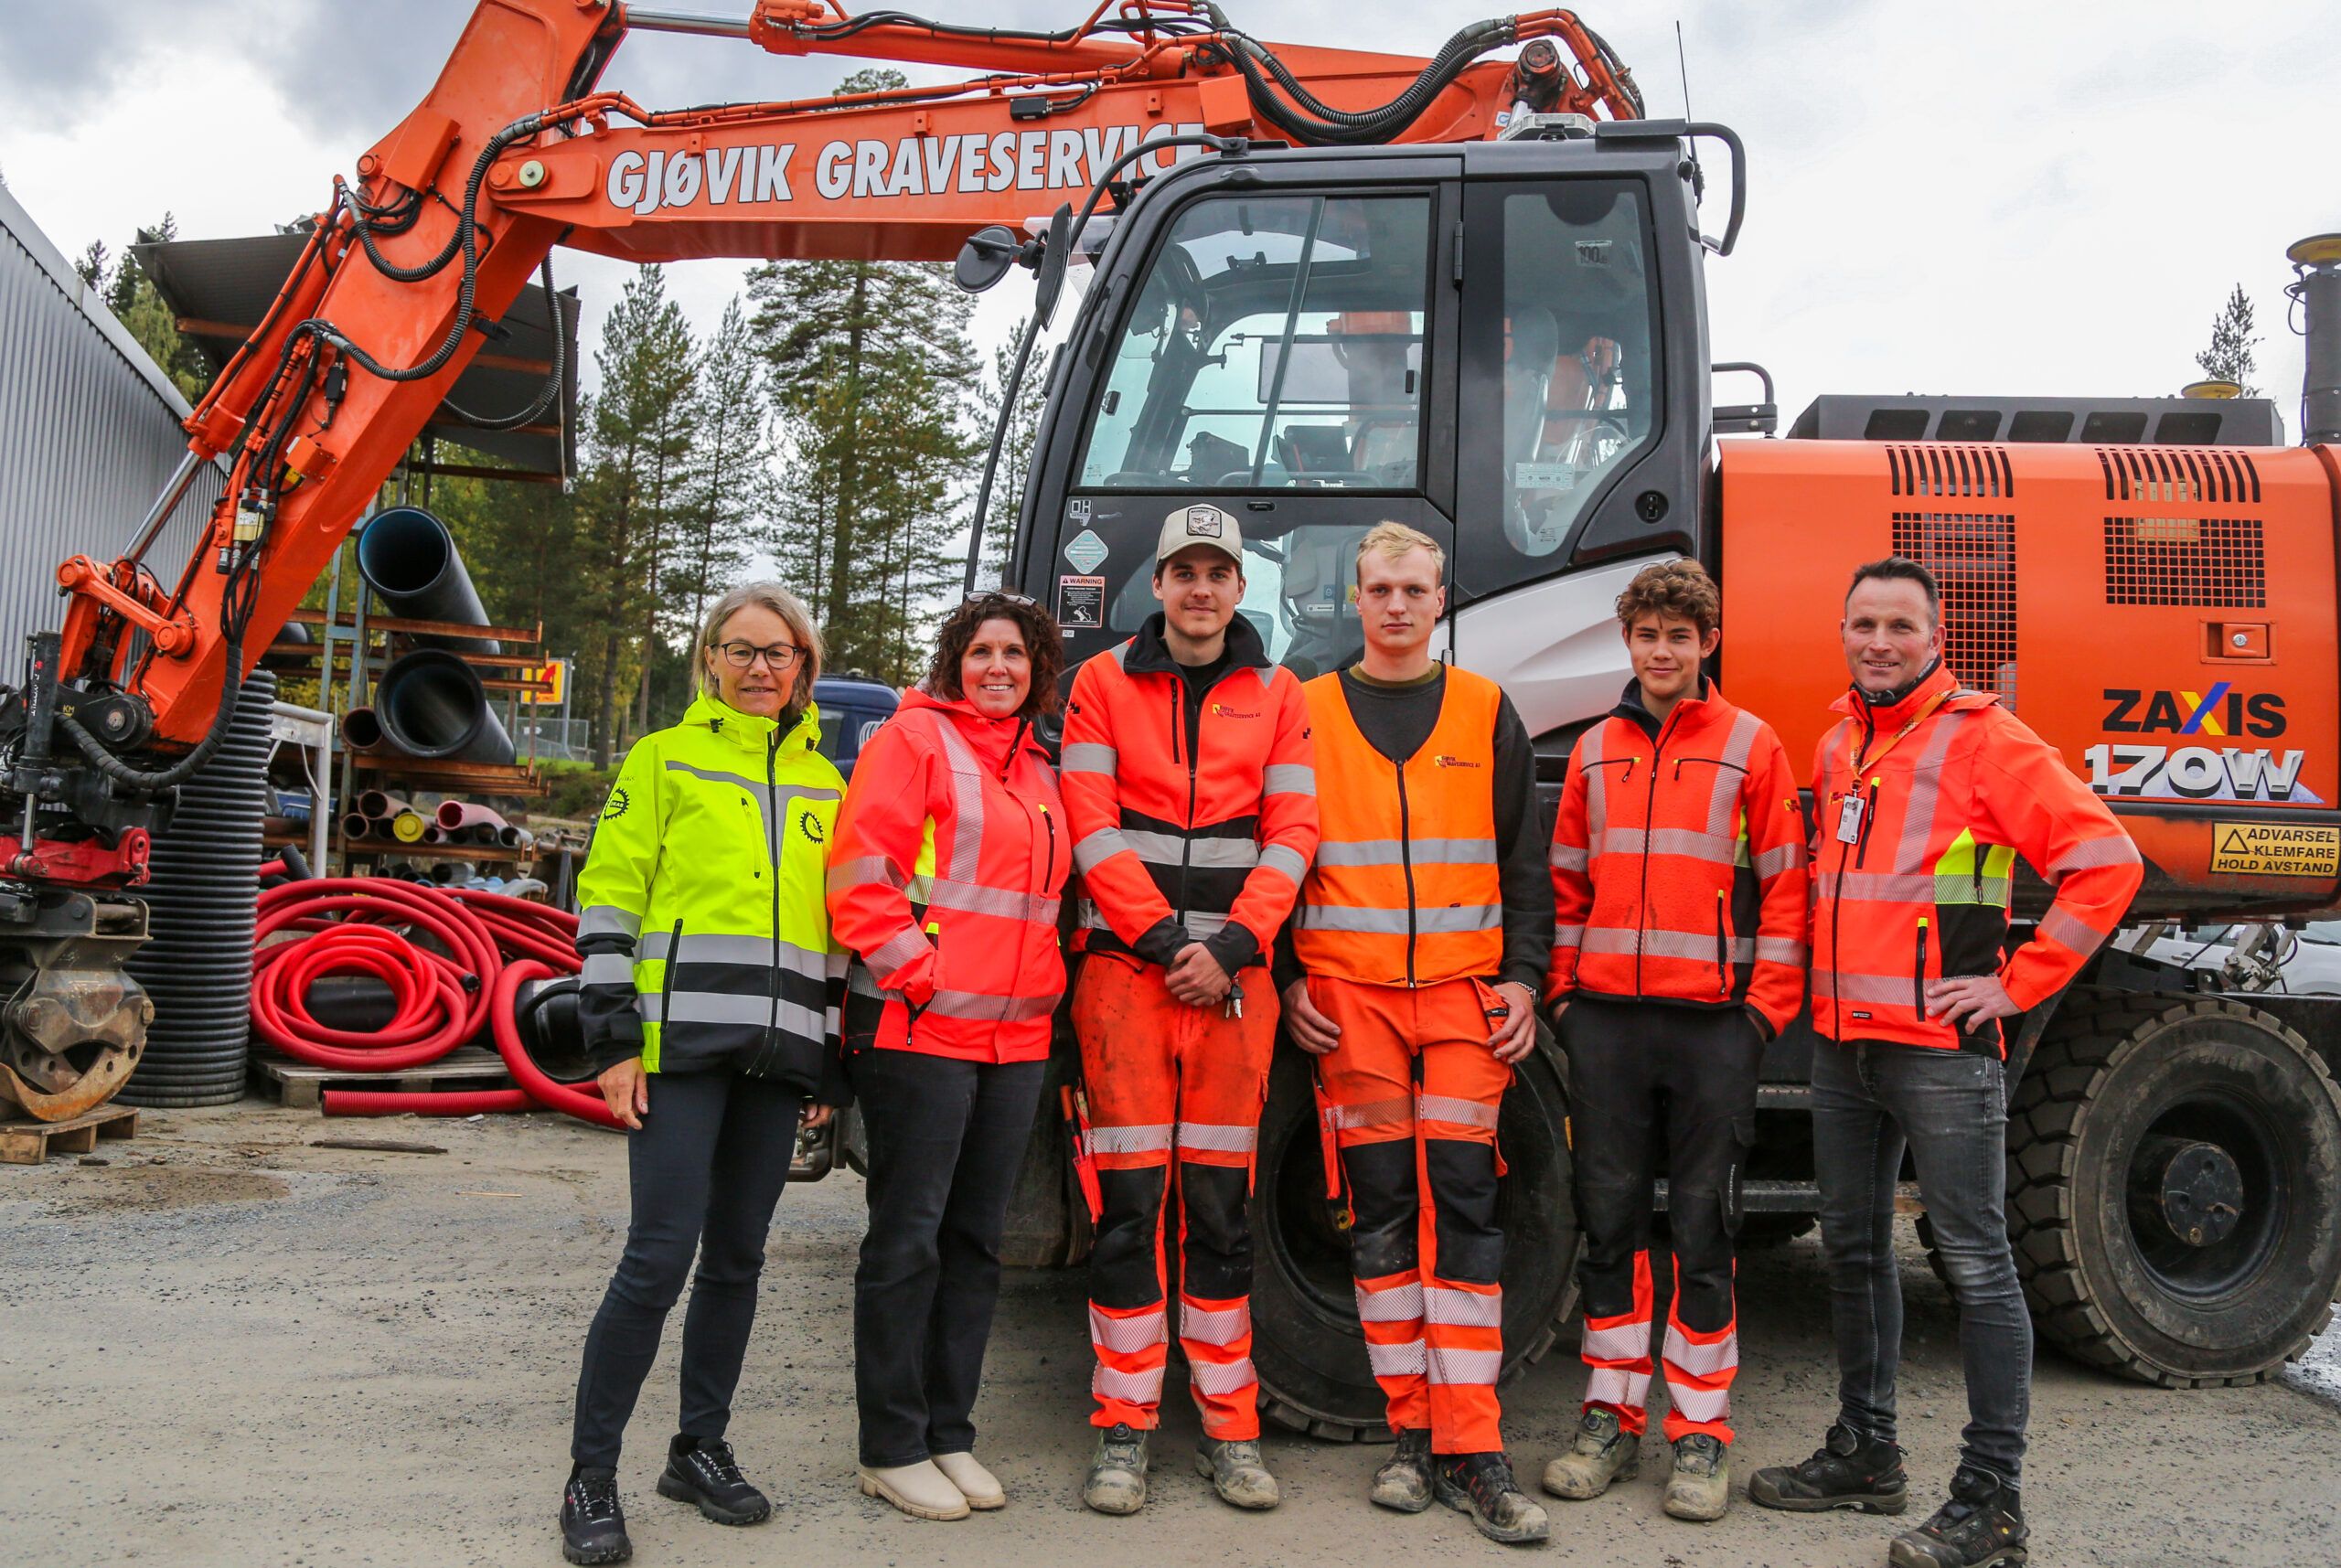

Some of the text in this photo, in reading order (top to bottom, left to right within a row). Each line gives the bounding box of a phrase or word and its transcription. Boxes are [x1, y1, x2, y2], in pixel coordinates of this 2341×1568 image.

[607, 143, 796, 215] GJØVIK
[2102, 681, 2287, 738] ZAXIS
[2084, 743, 2305, 801] 170W
[2247, 828, 2336, 843] ADVARSEL
[2253, 845, 2336, 859] KLEMFARE
[2217, 859, 2335, 874] HOLD AVSTAND
